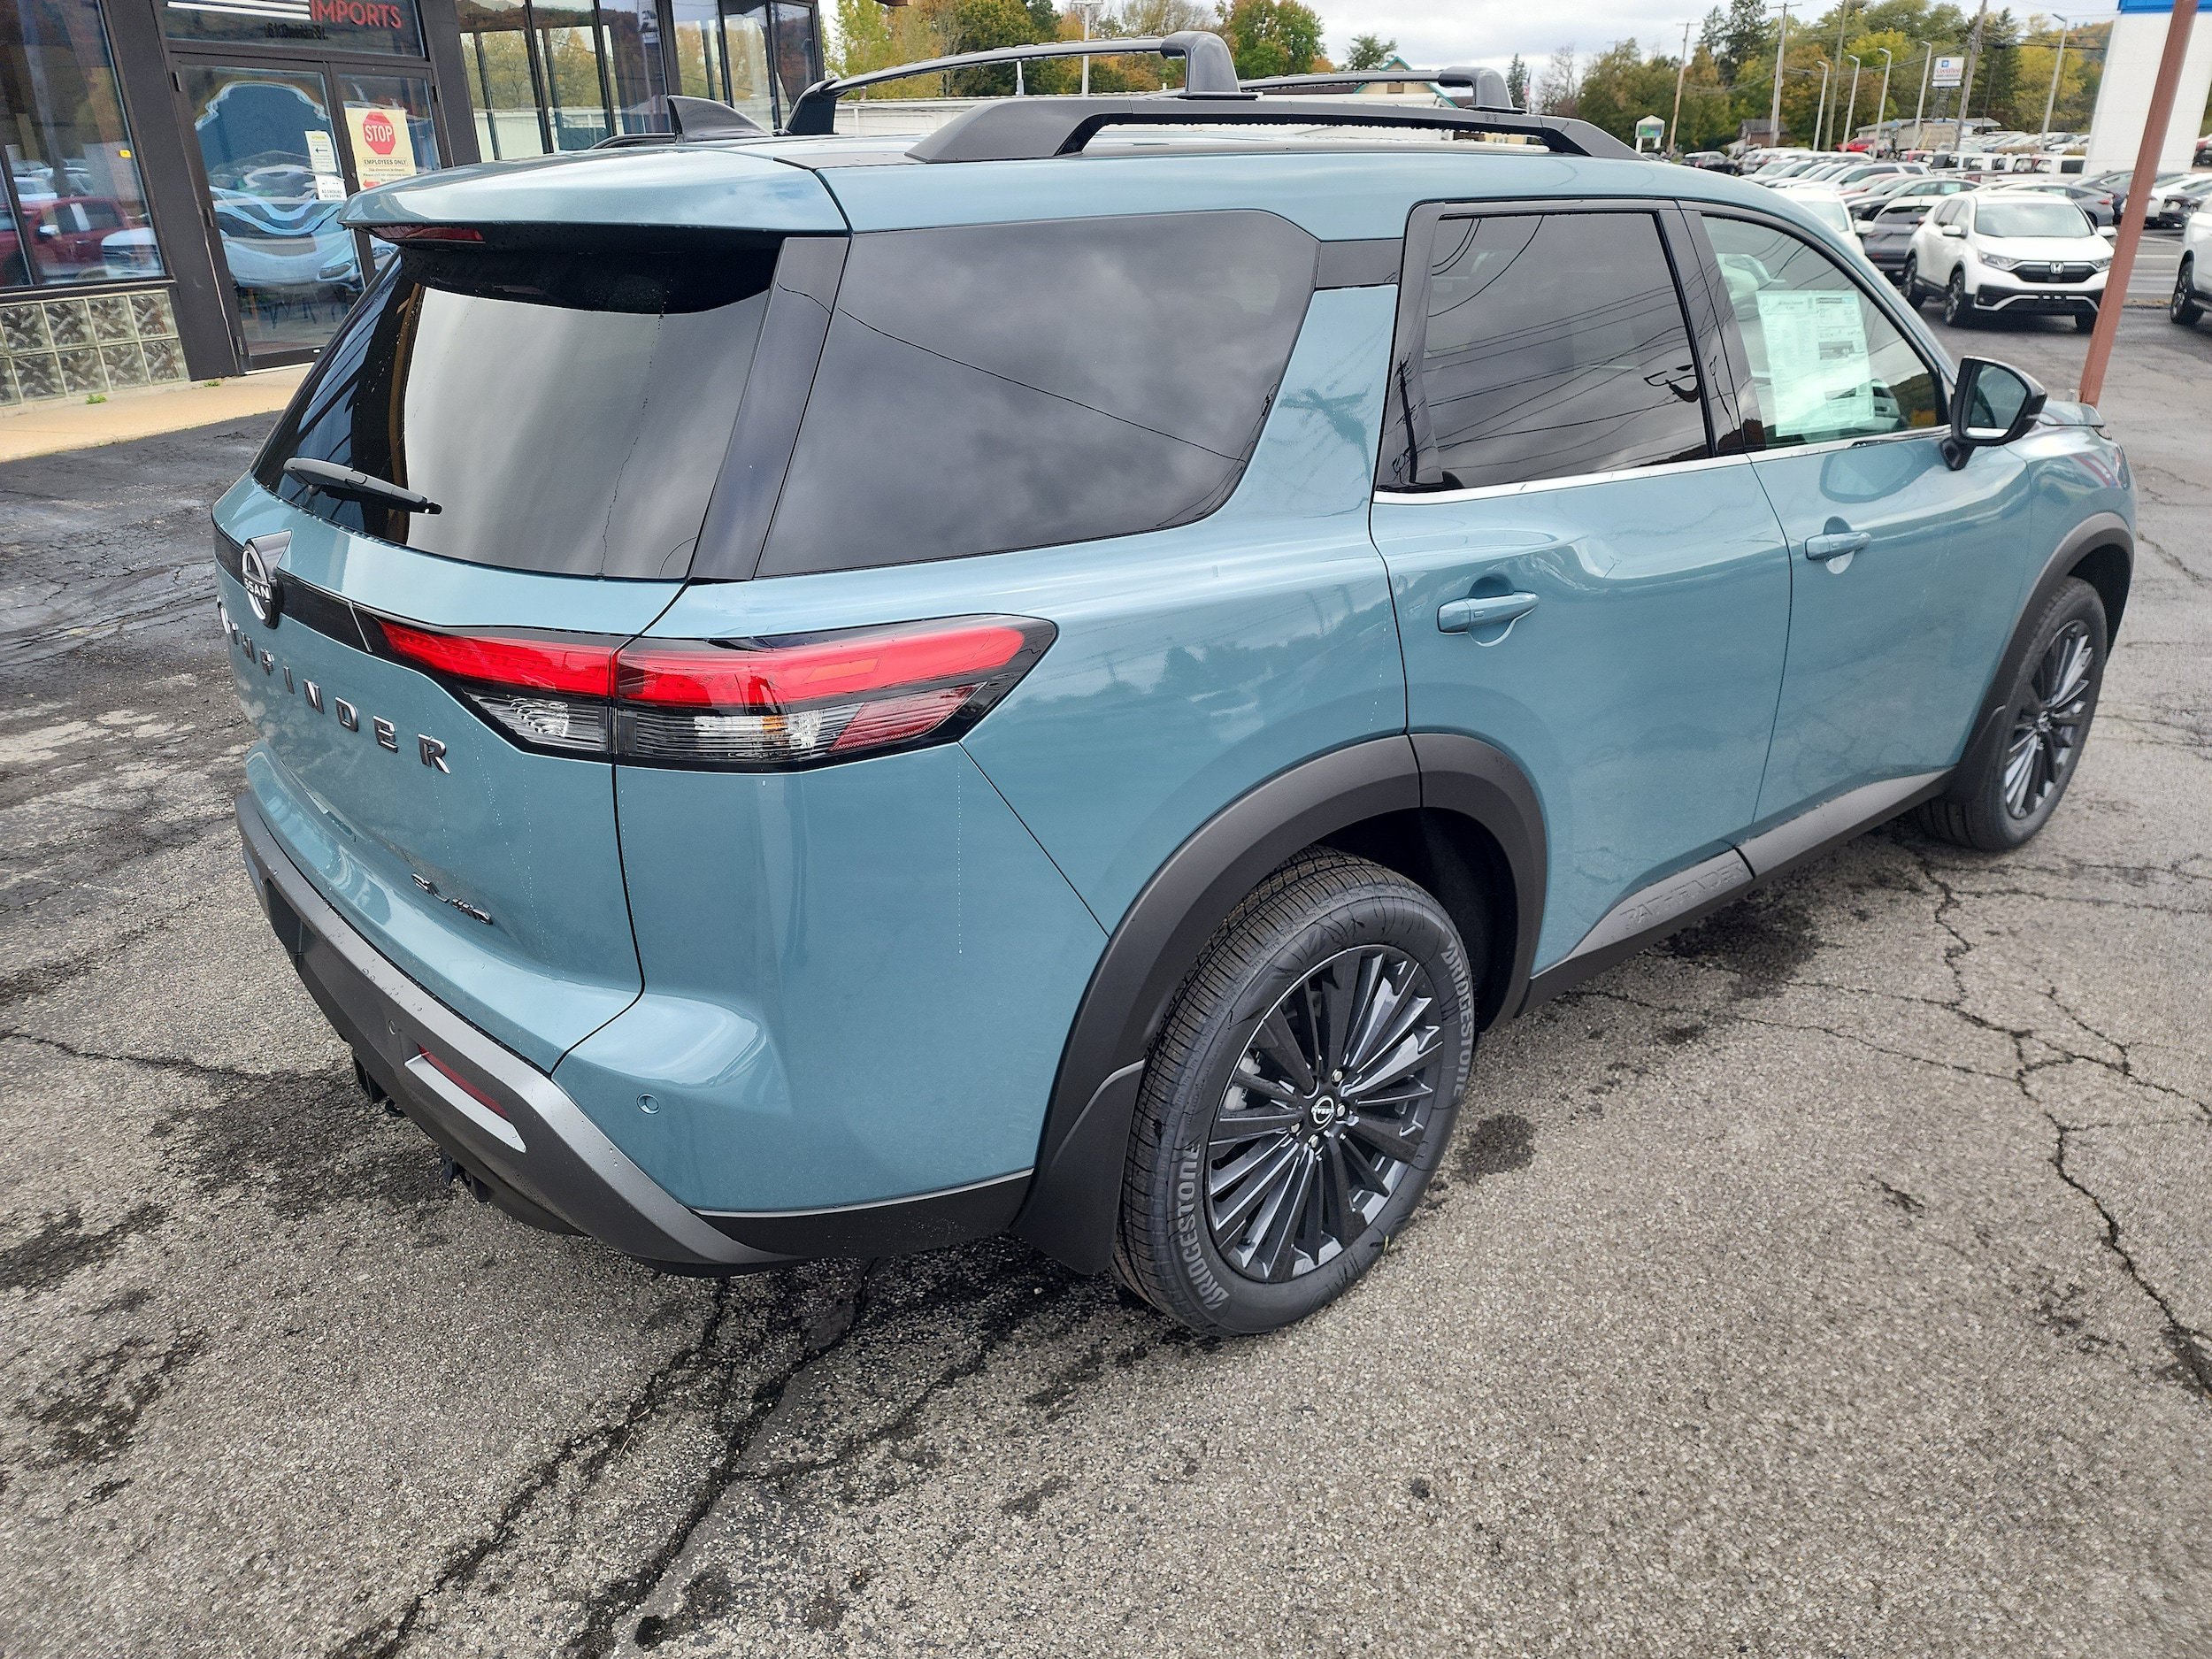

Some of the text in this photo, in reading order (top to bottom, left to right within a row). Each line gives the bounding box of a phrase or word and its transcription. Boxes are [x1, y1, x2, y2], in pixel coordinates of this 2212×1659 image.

[309, 0, 403, 29] IMPORTS
[365, 124, 393, 142] STOP
[243, 576, 272, 600] SSAN
[1441, 942, 1475, 1097] BRIDGESTONE
[1176, 1143, 1230, 1310] BRIDGESTONE
